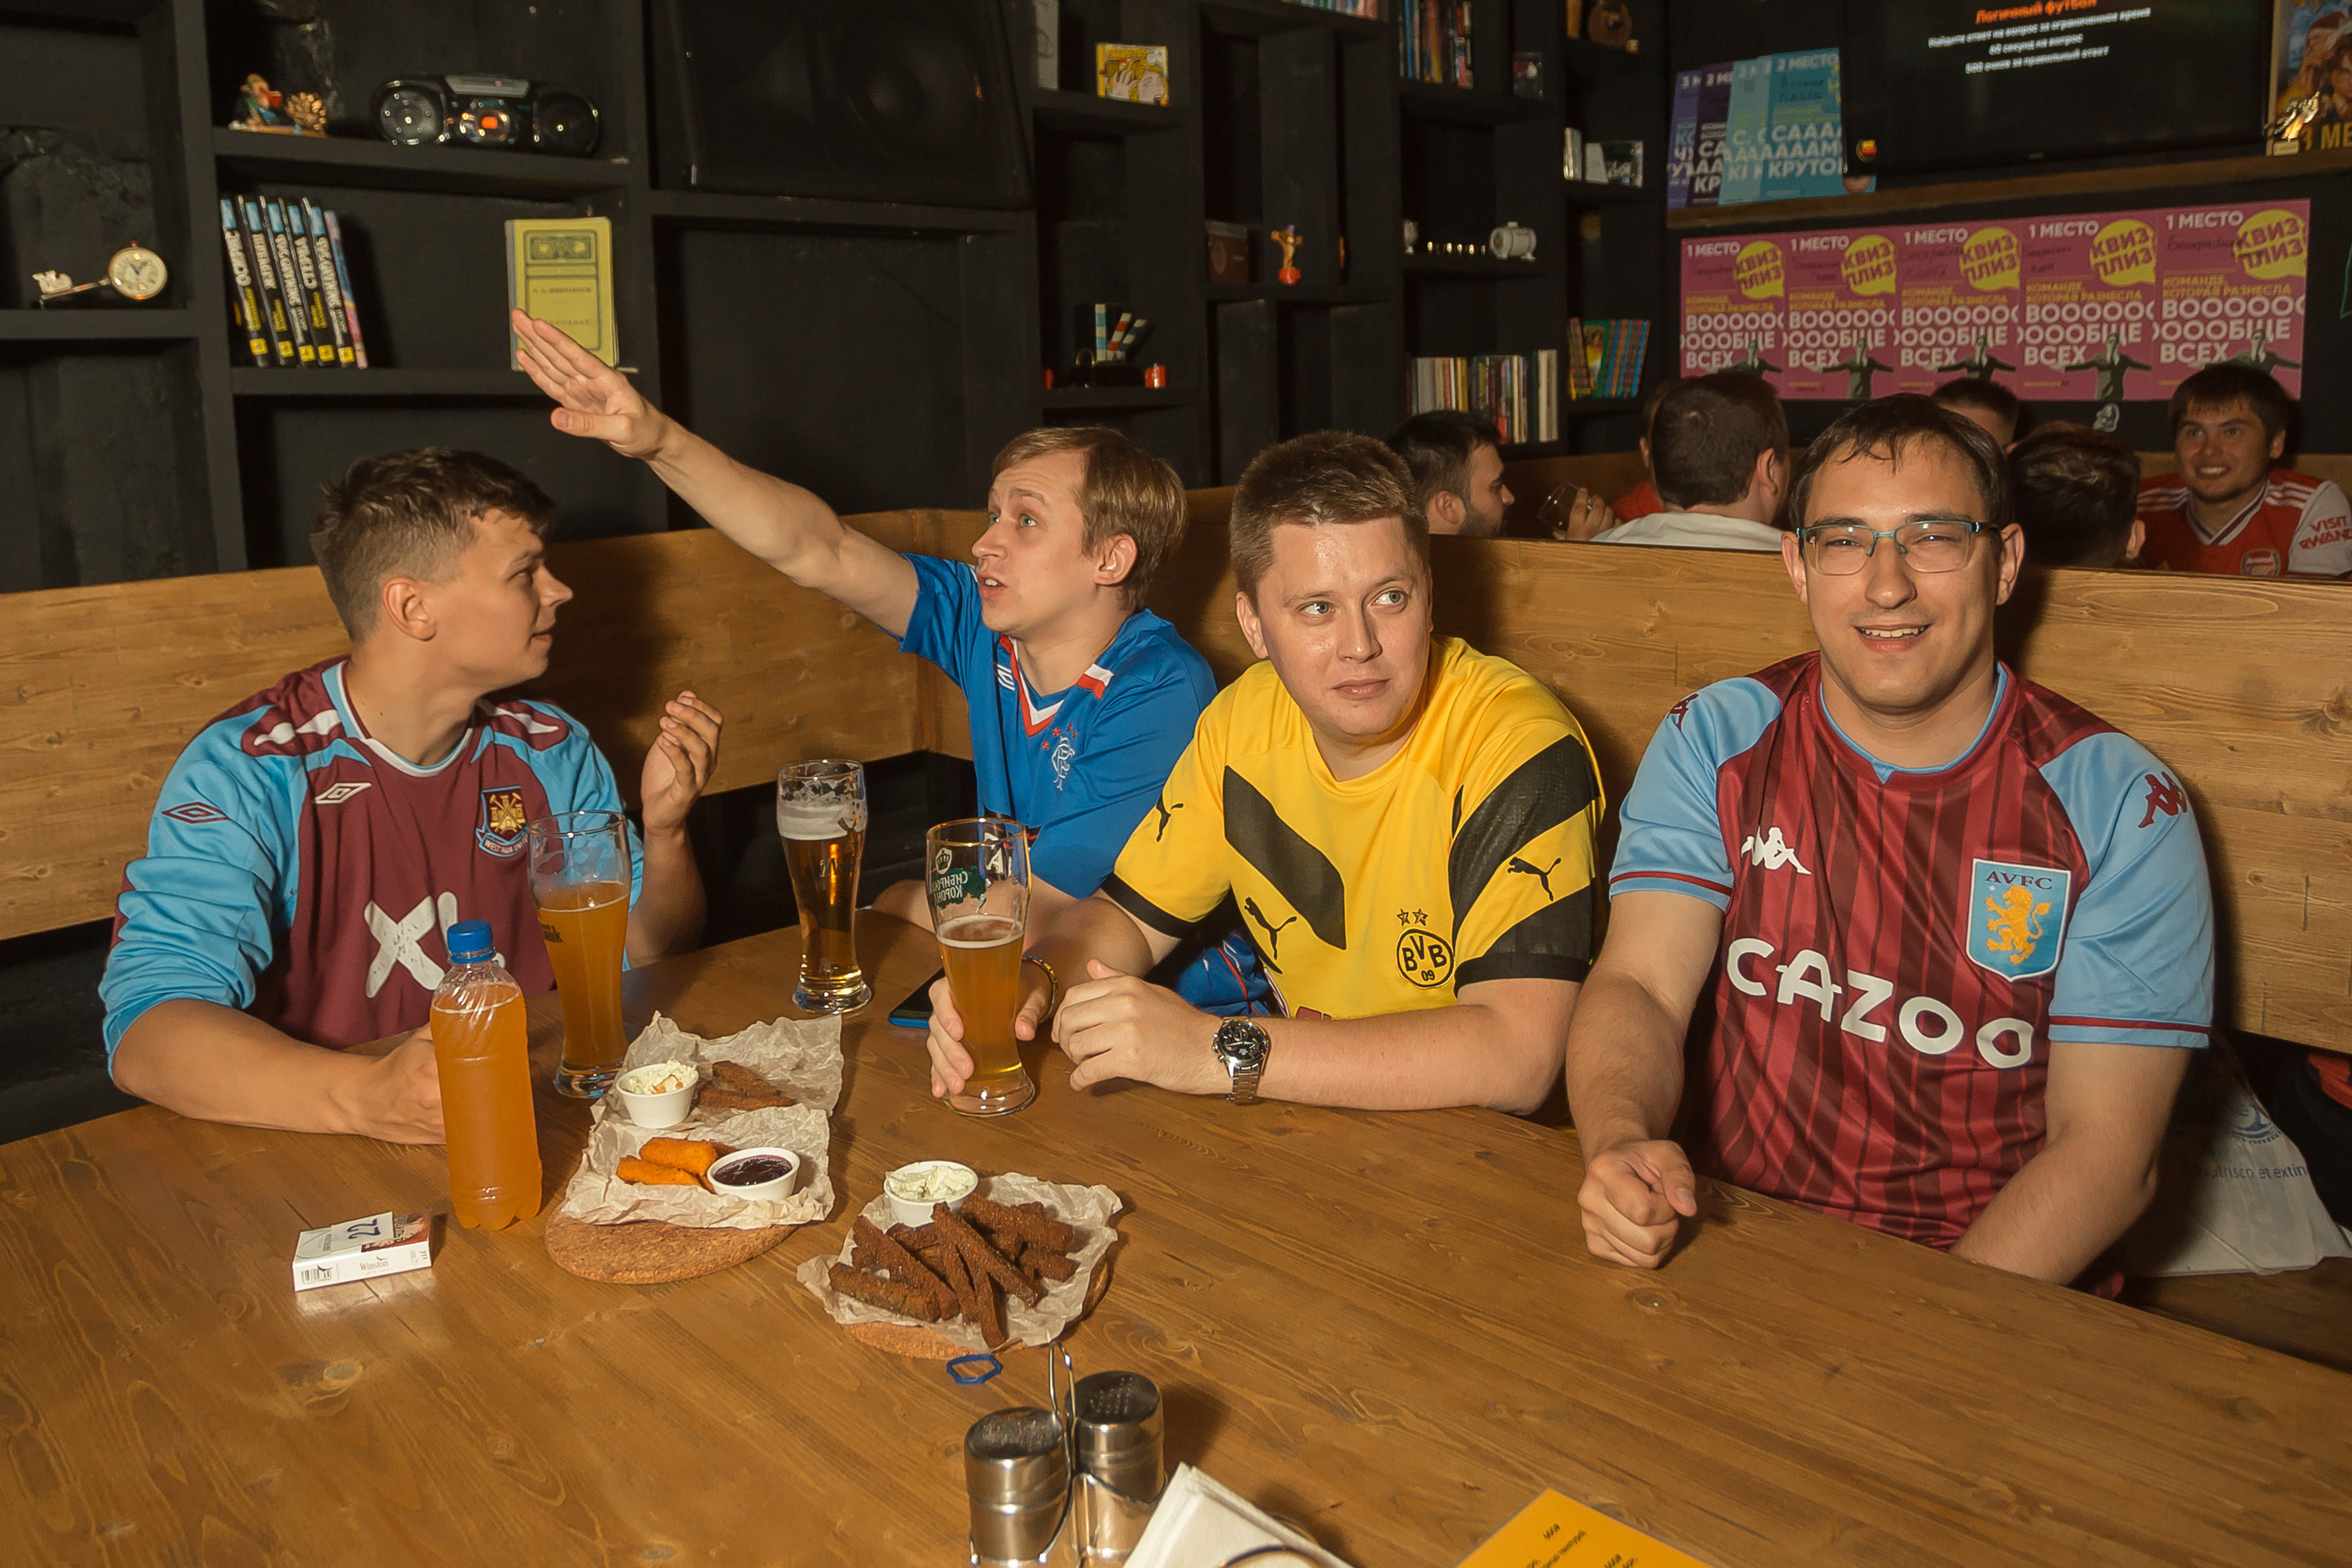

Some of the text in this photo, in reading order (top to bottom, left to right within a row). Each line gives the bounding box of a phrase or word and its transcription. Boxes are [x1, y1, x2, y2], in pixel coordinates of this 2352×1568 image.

[1768, 157, 1843, 179] КРУТО
[2029, 220, 2099, 239] 1 МЕСТО
[2165, 210, 2244, 230] 1 МЕСТО
[1791, 235, 1850, 251] 1 МЕСТО
[1904, 228, 1968, 244] 1 МЕСТО
[2092, 228, 2148, 258] КВИЗ
[2237, 218, 2298, 251] КВИЗ
[1687, 243, 1740, 256] 1 МЕСТО
[1844, 243, 1891, 270] КВИЗ
[1962, 234, 2015, 263] КВИЗ
[1736, 248, 1779, 273] КВИЗ
[1686, 351, 1734, 368] ВСЕХ
[1789, 349, 1840, 367] ВСЕХ
[1901, 347, 1958, 367] ВСЕХ
[2024, 345, 2087, 367] ВСЕХ
[2160, 342, 2230, 364] ВСЕХ
[2310, 515, 2346, 533] VISIT
[484, 839, 501, 852] WEST
[1984, 871, 2052, 890] AVFC
[1402, 935, 1447, 971] BVB
[1420, 969, 1435, 981] 09
[1726, 938, 2034, 1068] CAZOO
[2258, 1167, 2271, 1179] et
[359, 1260, 389, 1271] Winston
